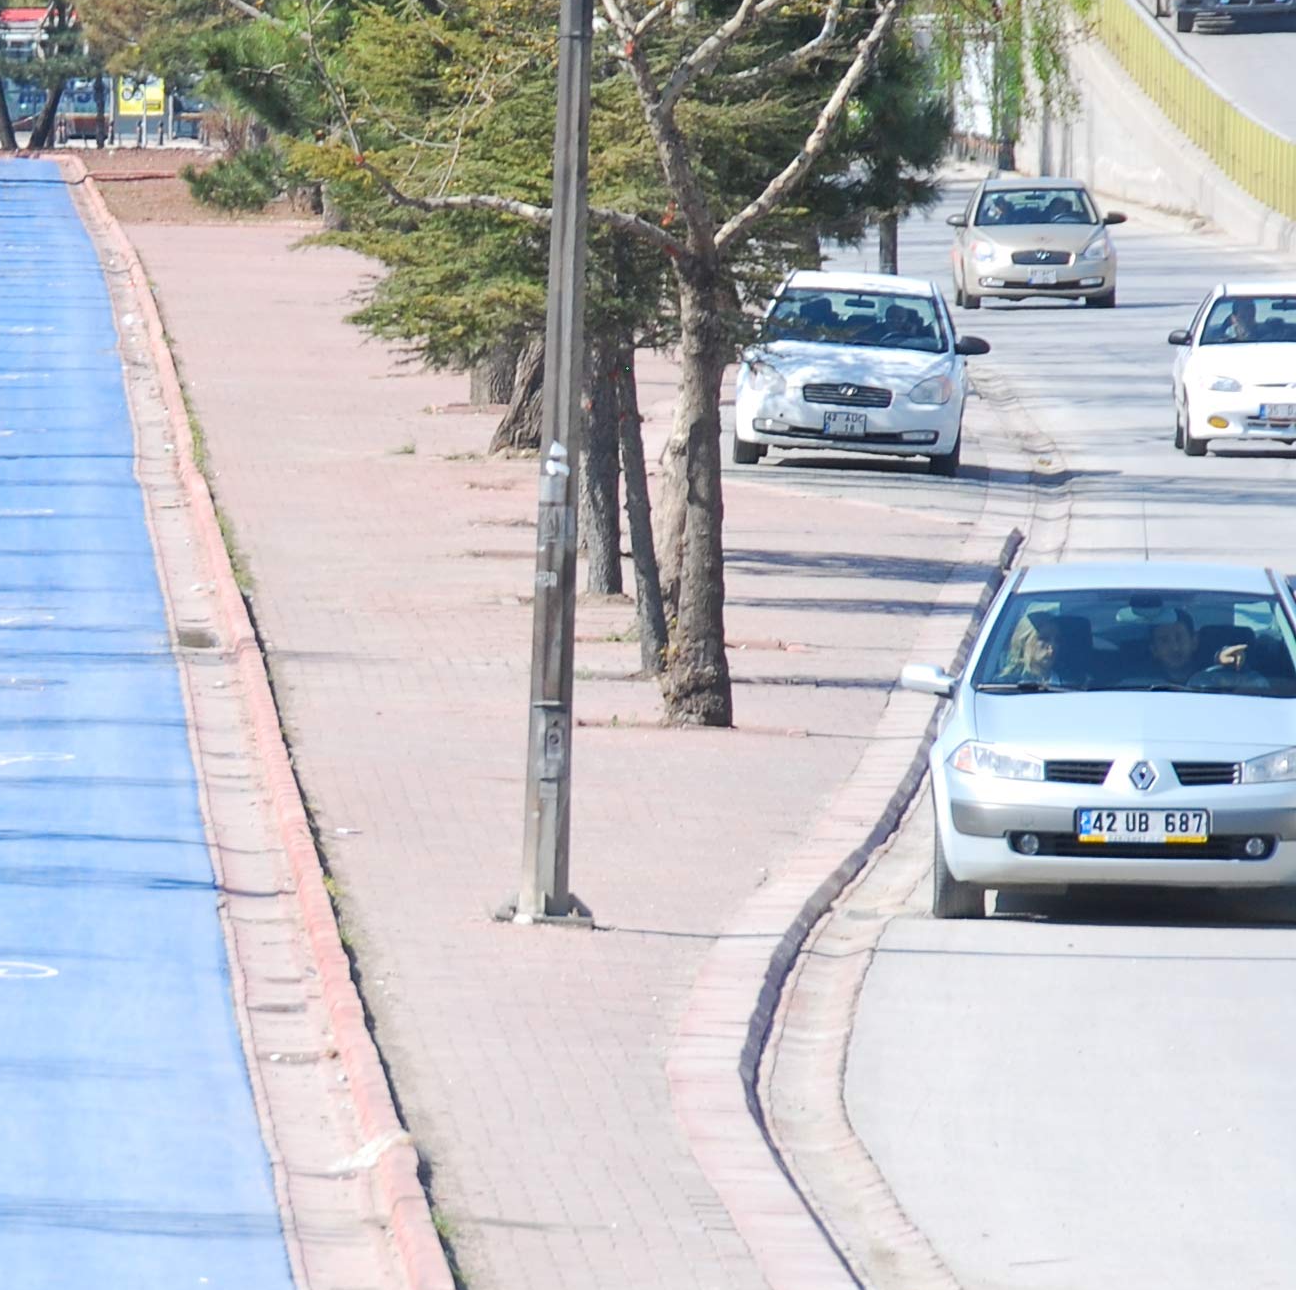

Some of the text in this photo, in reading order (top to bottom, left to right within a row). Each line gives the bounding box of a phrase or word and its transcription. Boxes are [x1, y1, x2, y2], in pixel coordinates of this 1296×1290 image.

[1092, 812, 1203, 833] 42 UB 687
